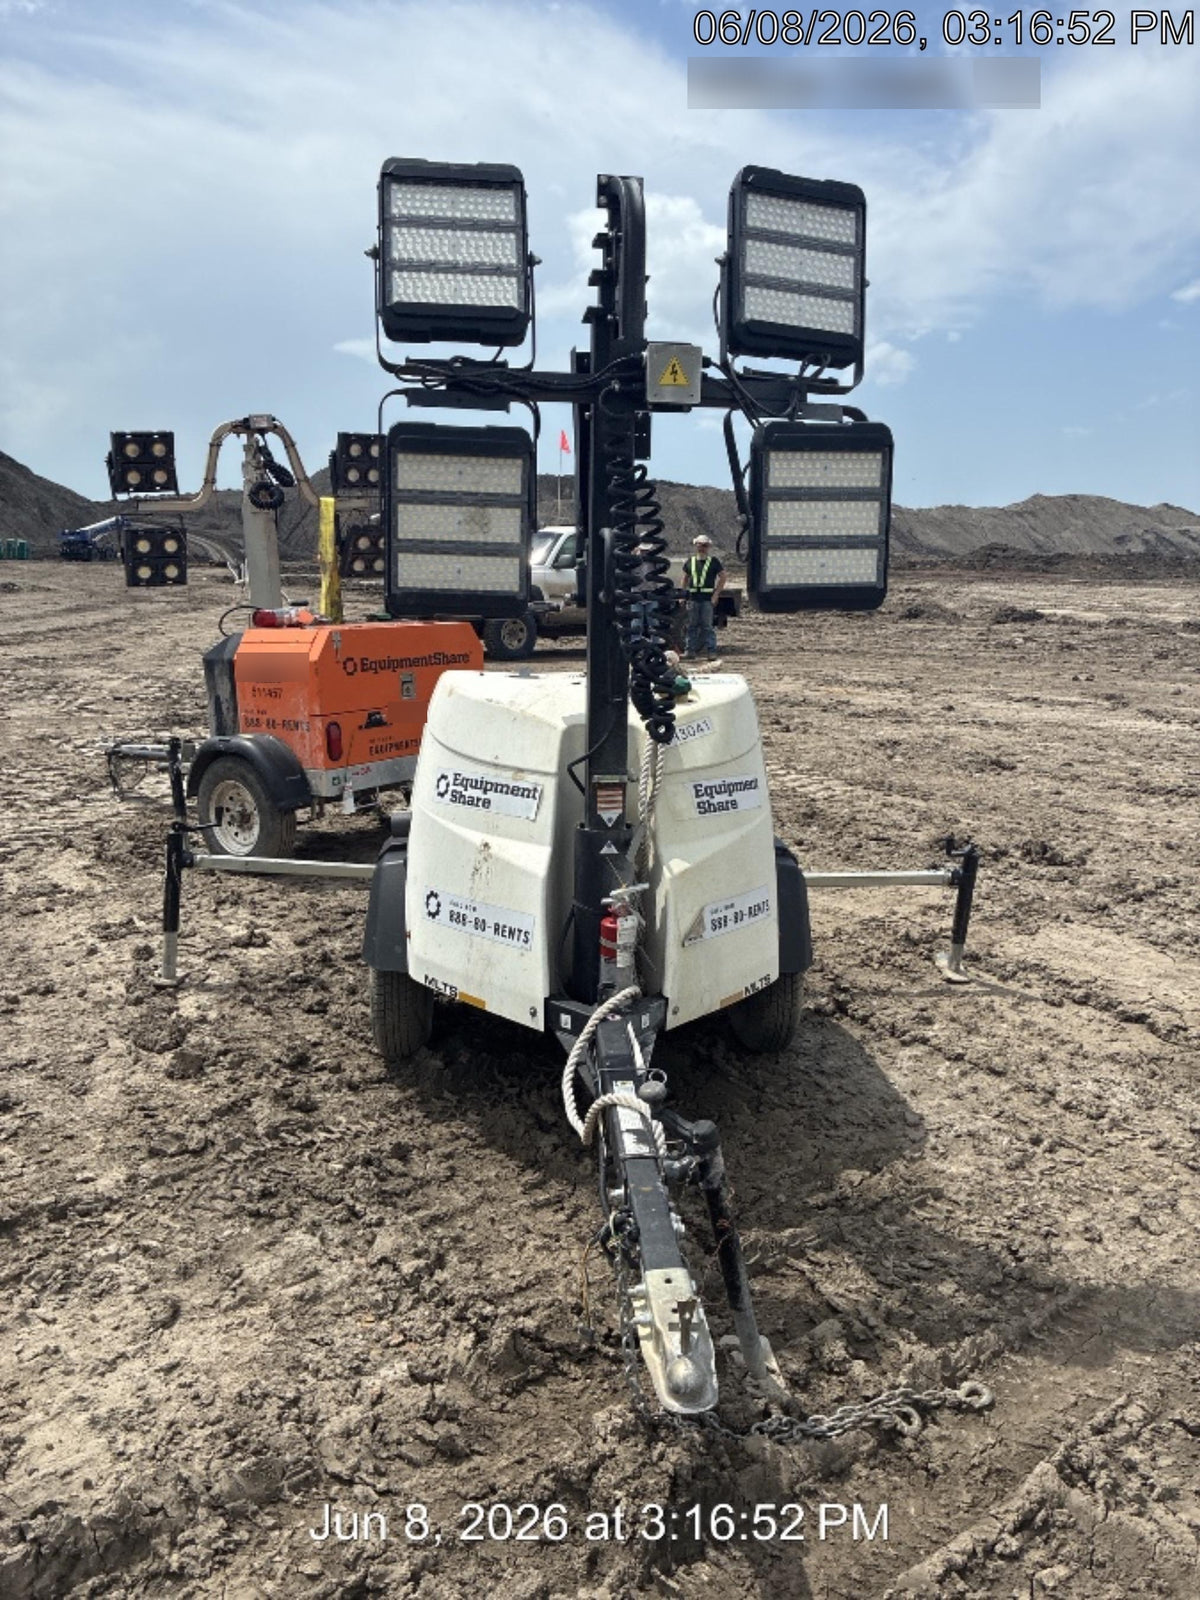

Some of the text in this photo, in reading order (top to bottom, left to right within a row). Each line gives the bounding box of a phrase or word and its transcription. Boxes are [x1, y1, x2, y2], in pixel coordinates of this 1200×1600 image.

[360, 652, 470, 674] EquipmentShare
[452, 773, 539, 800] Equipment
[693, 778, 758, 798] Equipment
[450, 789, 491, 810] Share
[697, 799, 738, 815] Share
[449, 910, 530, 944] 888-80-RENTS
